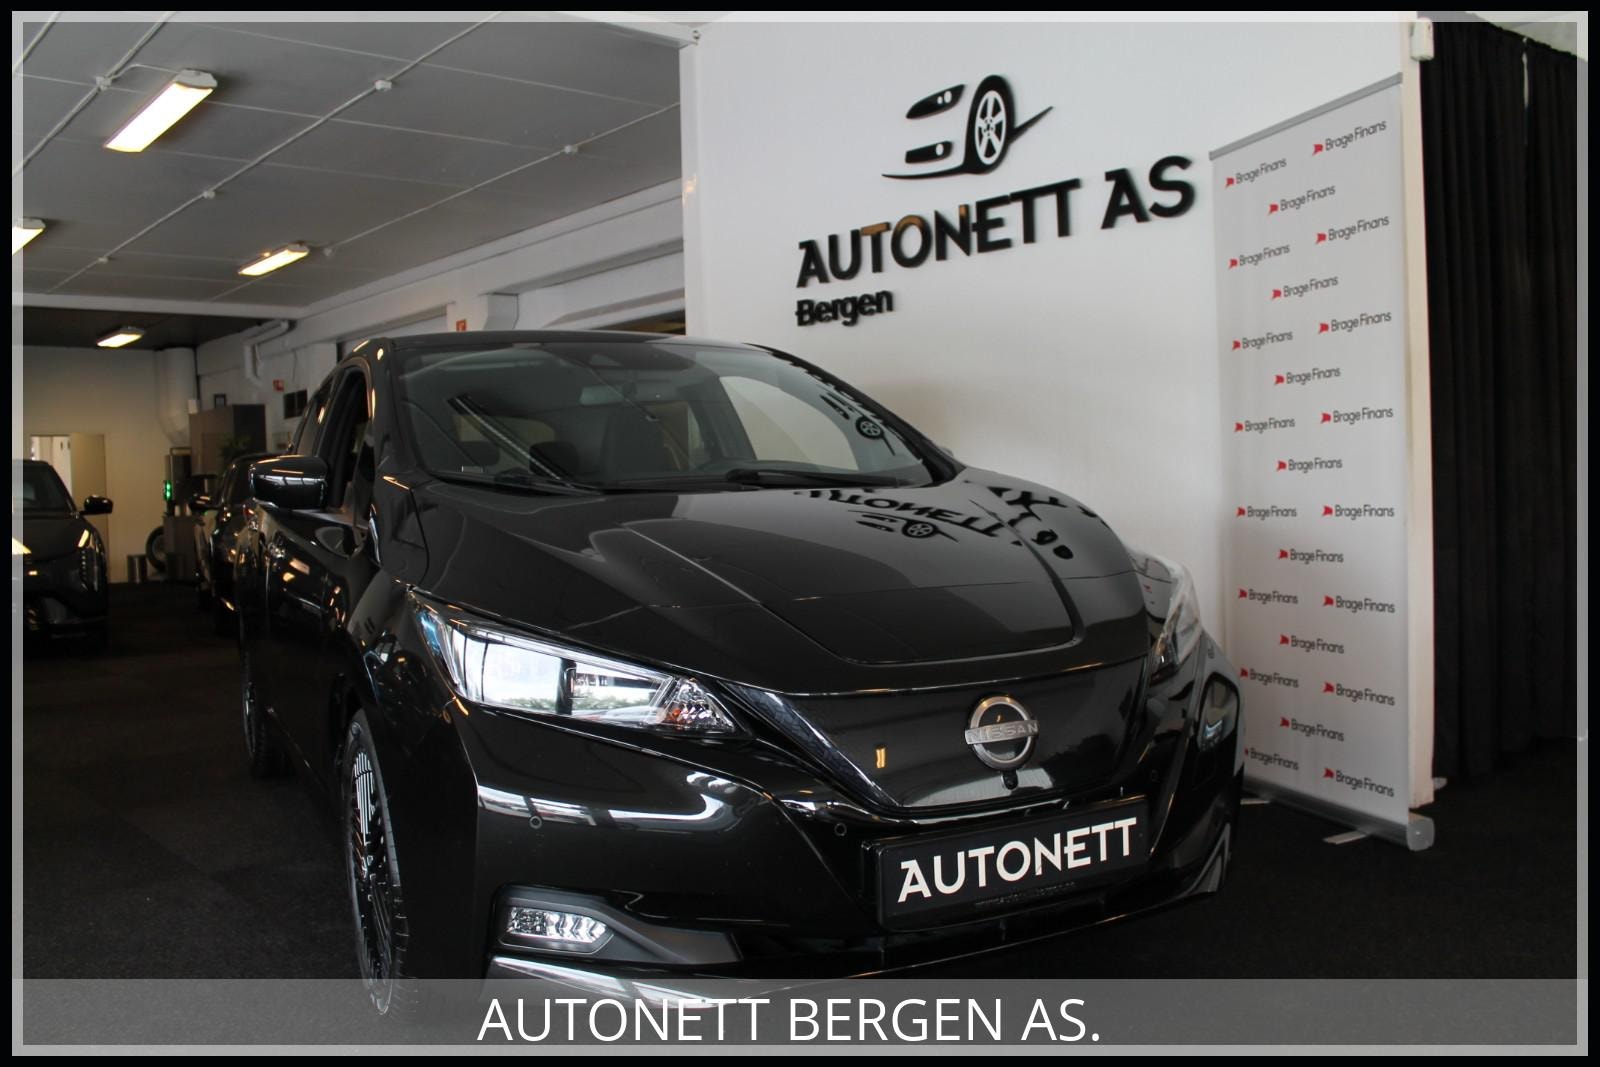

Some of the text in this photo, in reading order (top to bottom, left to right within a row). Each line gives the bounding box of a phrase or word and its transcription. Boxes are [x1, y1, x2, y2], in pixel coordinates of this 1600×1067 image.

[1325, 121, 1386, 151] Brage Finans
[1280, 186, 1335, 211] Brage Finans
[796, 155, 1196, 288] AUTONETT AS
[1328, 216, 1390, 241] Brage Finans
[1283, 276, 1338, 297] Brage Finans
[796, 289, 894, 327] Bergen
[1331, 312, 1392, 332] Brage Finans
[1286, 368, 1341, 385] Brage Finans
[1333, 407, 1393, 425] Brage Finans
[1288, 457, 1342, 474] Brage Finans
[1335, 505, 1394, 520] Brage Finans
[1290, 549, 1344, 564] Brage Finans
[1336, 596, 1395, 613] Brage Finans
[1291, 635, 1344, 654] Brage Finans
[1336, 684, 1395, 706] Brage Finans
[967, 721, 1039, 743] NISSAN
[1291, 719, 1344, 742] Brage Finans
[1336, 770, 1394, 797] Brage Finans
[898, 817, 1137, 903] AUTONETT
